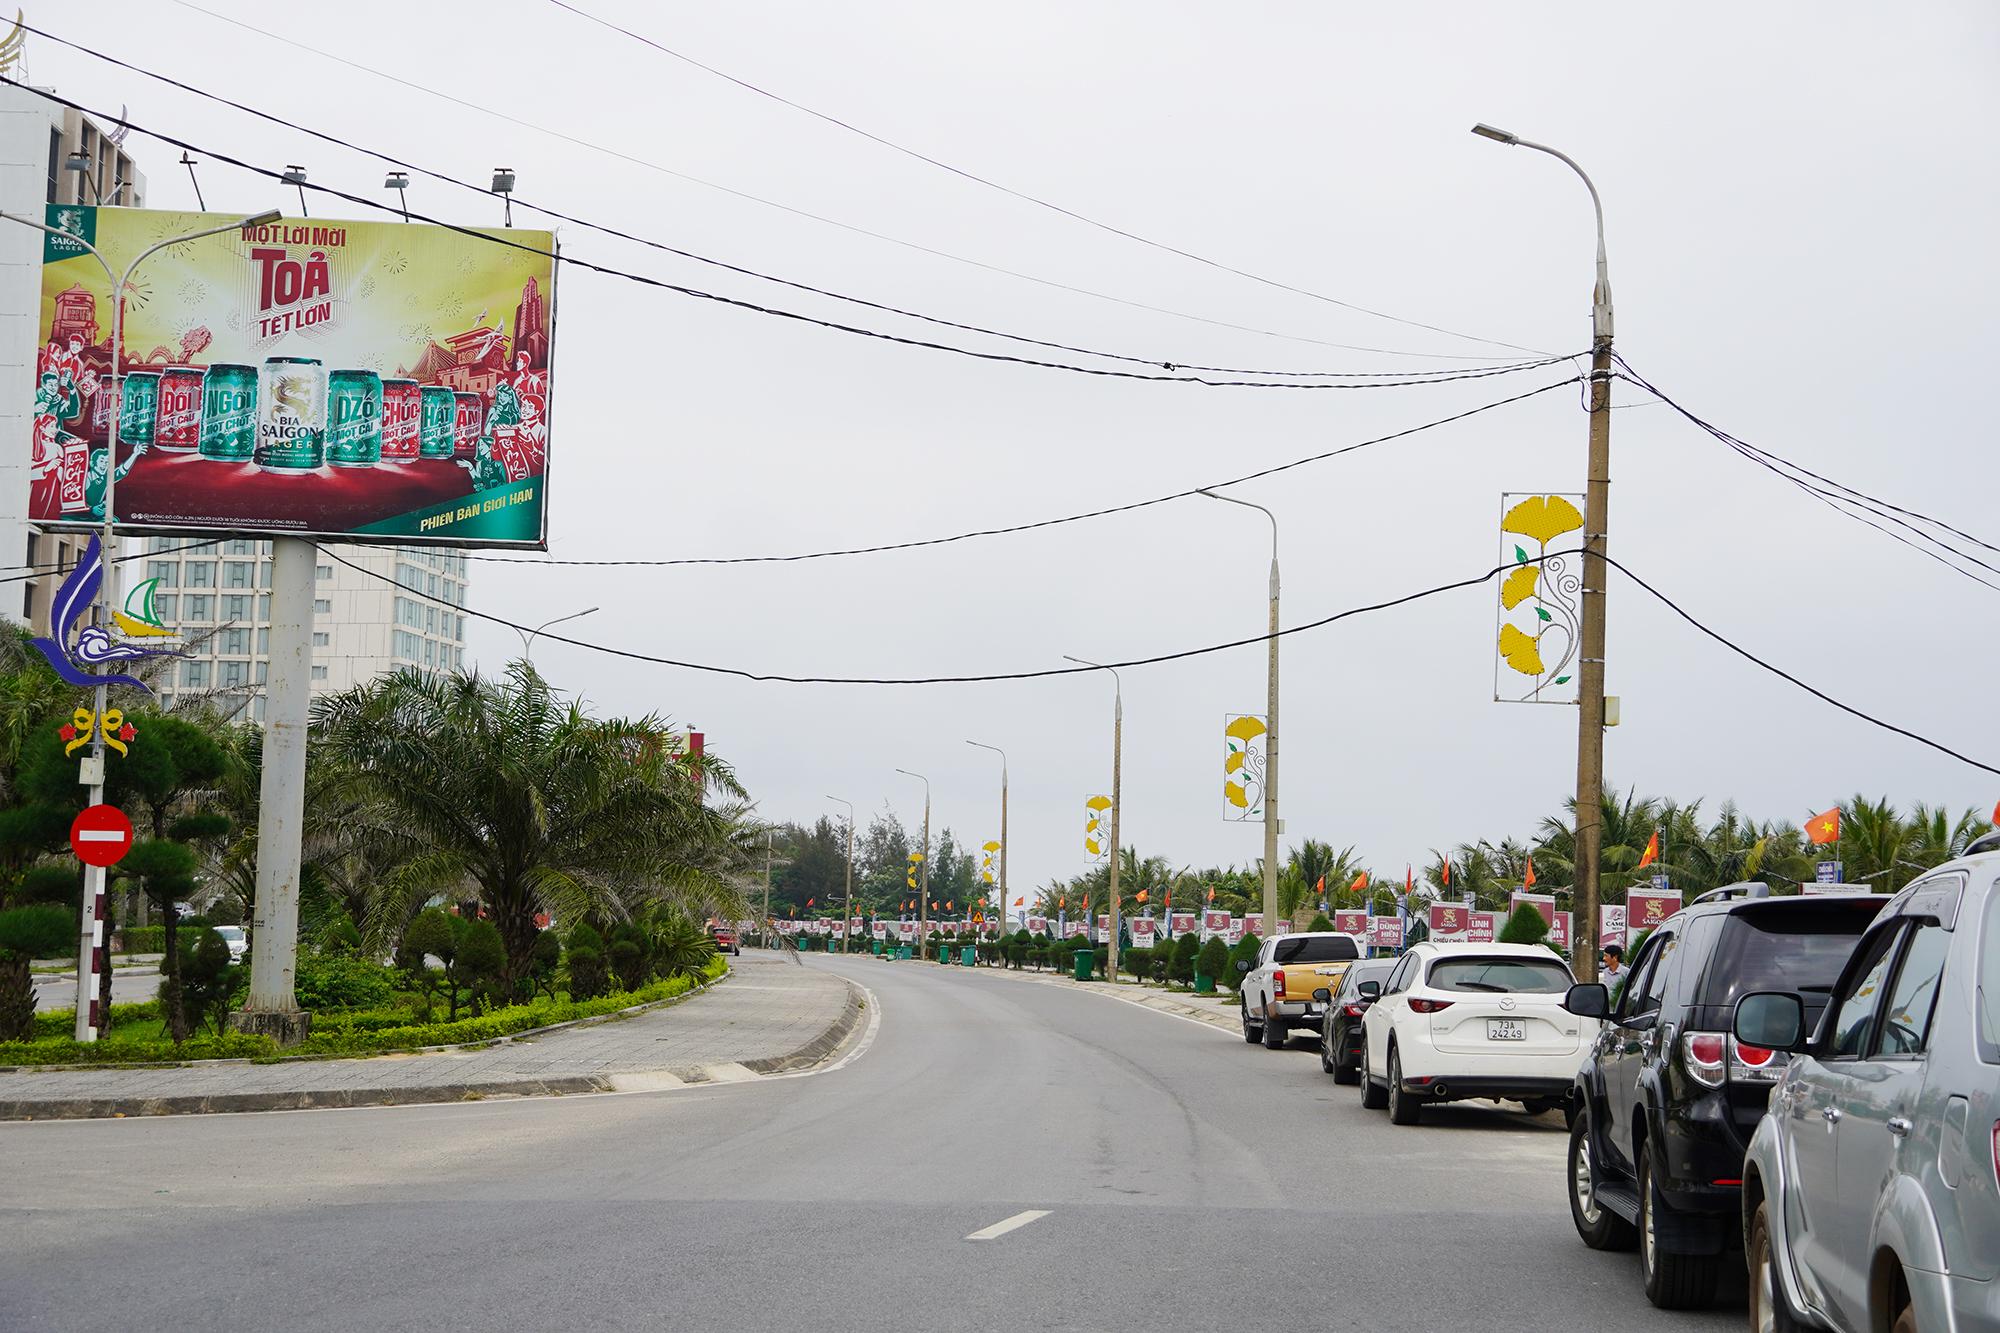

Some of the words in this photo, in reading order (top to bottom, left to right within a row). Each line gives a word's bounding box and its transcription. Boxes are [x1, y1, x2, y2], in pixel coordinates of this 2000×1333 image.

[241, 224, 281, 245] MỘT
[283, 226, 310, 245] LỜI
[312, 228, 346, 247] MỜI
[259, 312, 294, 338] TẾT
[295, 301, 331, 329] LỚN
[177, 412, 195, 425] CÂU
[382, 400, 420, 427] CHÚC
[225, 414, 251, 430] CHÚT
[280, 416, 299, 425] BIA
[262, 424, 320, 439] SAIGON
[264, 439, 314, 449] LAGER
[420, 511, 454, 533] PHIÊN
[457, 503, 481, 521] BẢN
[483, 495, 506, 512] GIỚI
[509, 488, 534, 505] HẠN
[87, 905, 93, 913] 2
[1471, 920, 1489, 928] LINH
[1499, 1021, 1515, 1030] 73A
[1492, 1030, 1522, 1039] 242.49
